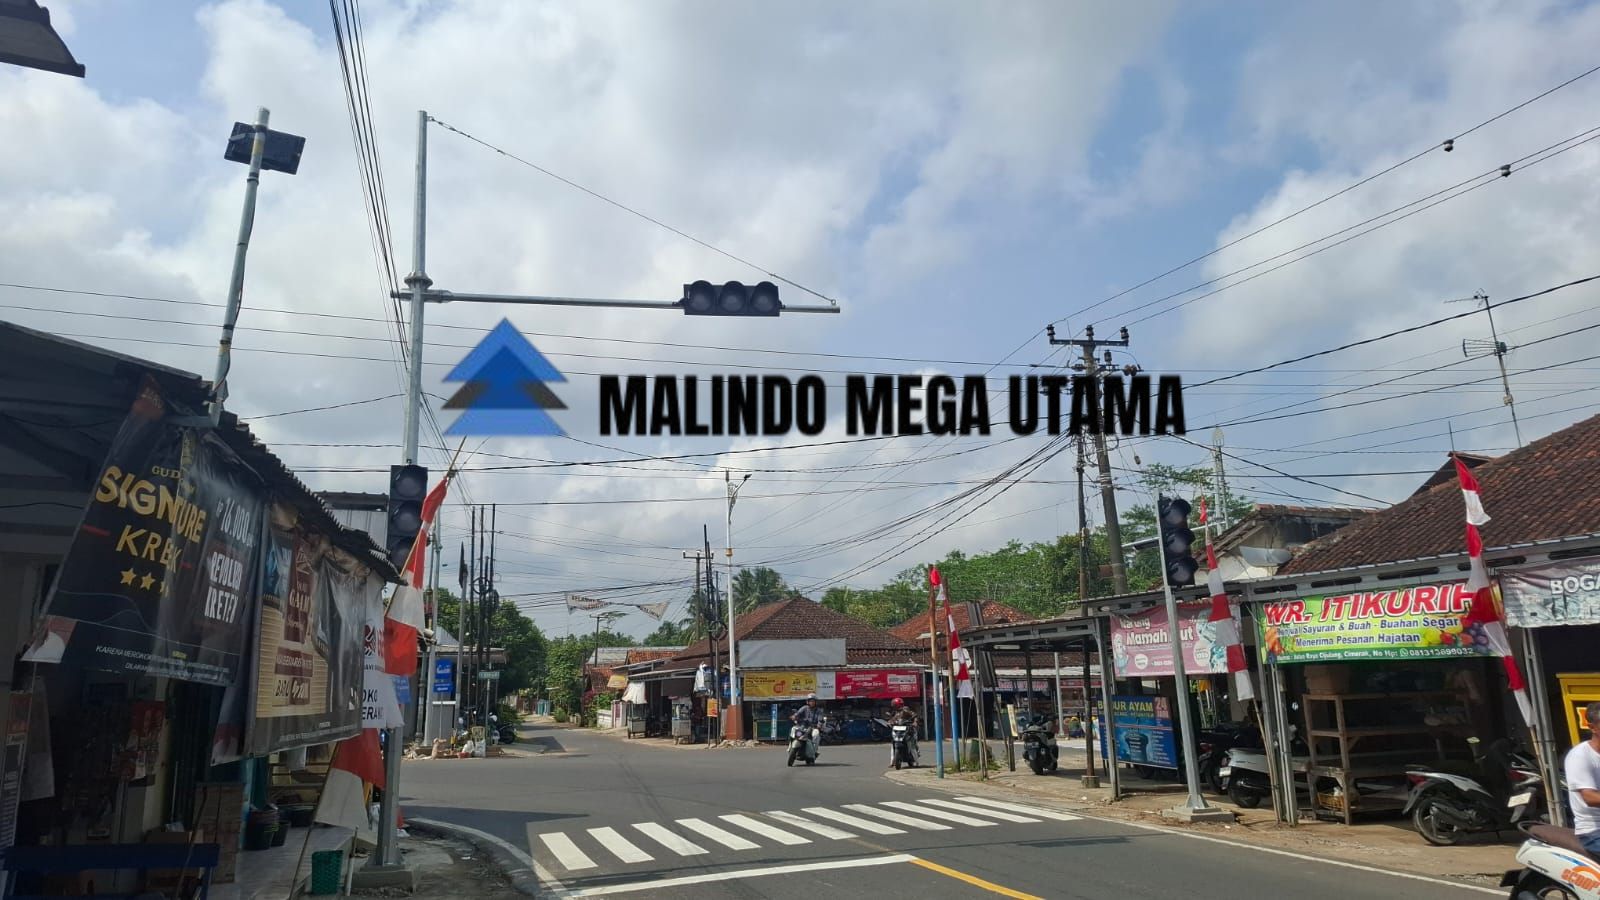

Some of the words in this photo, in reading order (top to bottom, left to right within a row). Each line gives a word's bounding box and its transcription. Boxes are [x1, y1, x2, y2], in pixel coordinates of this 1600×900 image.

[1550, 574, 1600, 595] BOG
[1263, 600, 1313, 627] WR.
[1303, 624, 1336, 635] Sayuran
[1348, 621, 1371, 631] Buah
[1380, 619, 1418, 629] Buahan
[1423, 617, 1459, 629] Segar
[1126, 628, 1168, 645] Mamah
[1296, 637, 1334, 647] Menerima
[1337, 635, 1375, 645] Pesanan
[1378, 633, 1420, 645] Hajatan
[1129, 702, 1153, 712] AYAM
